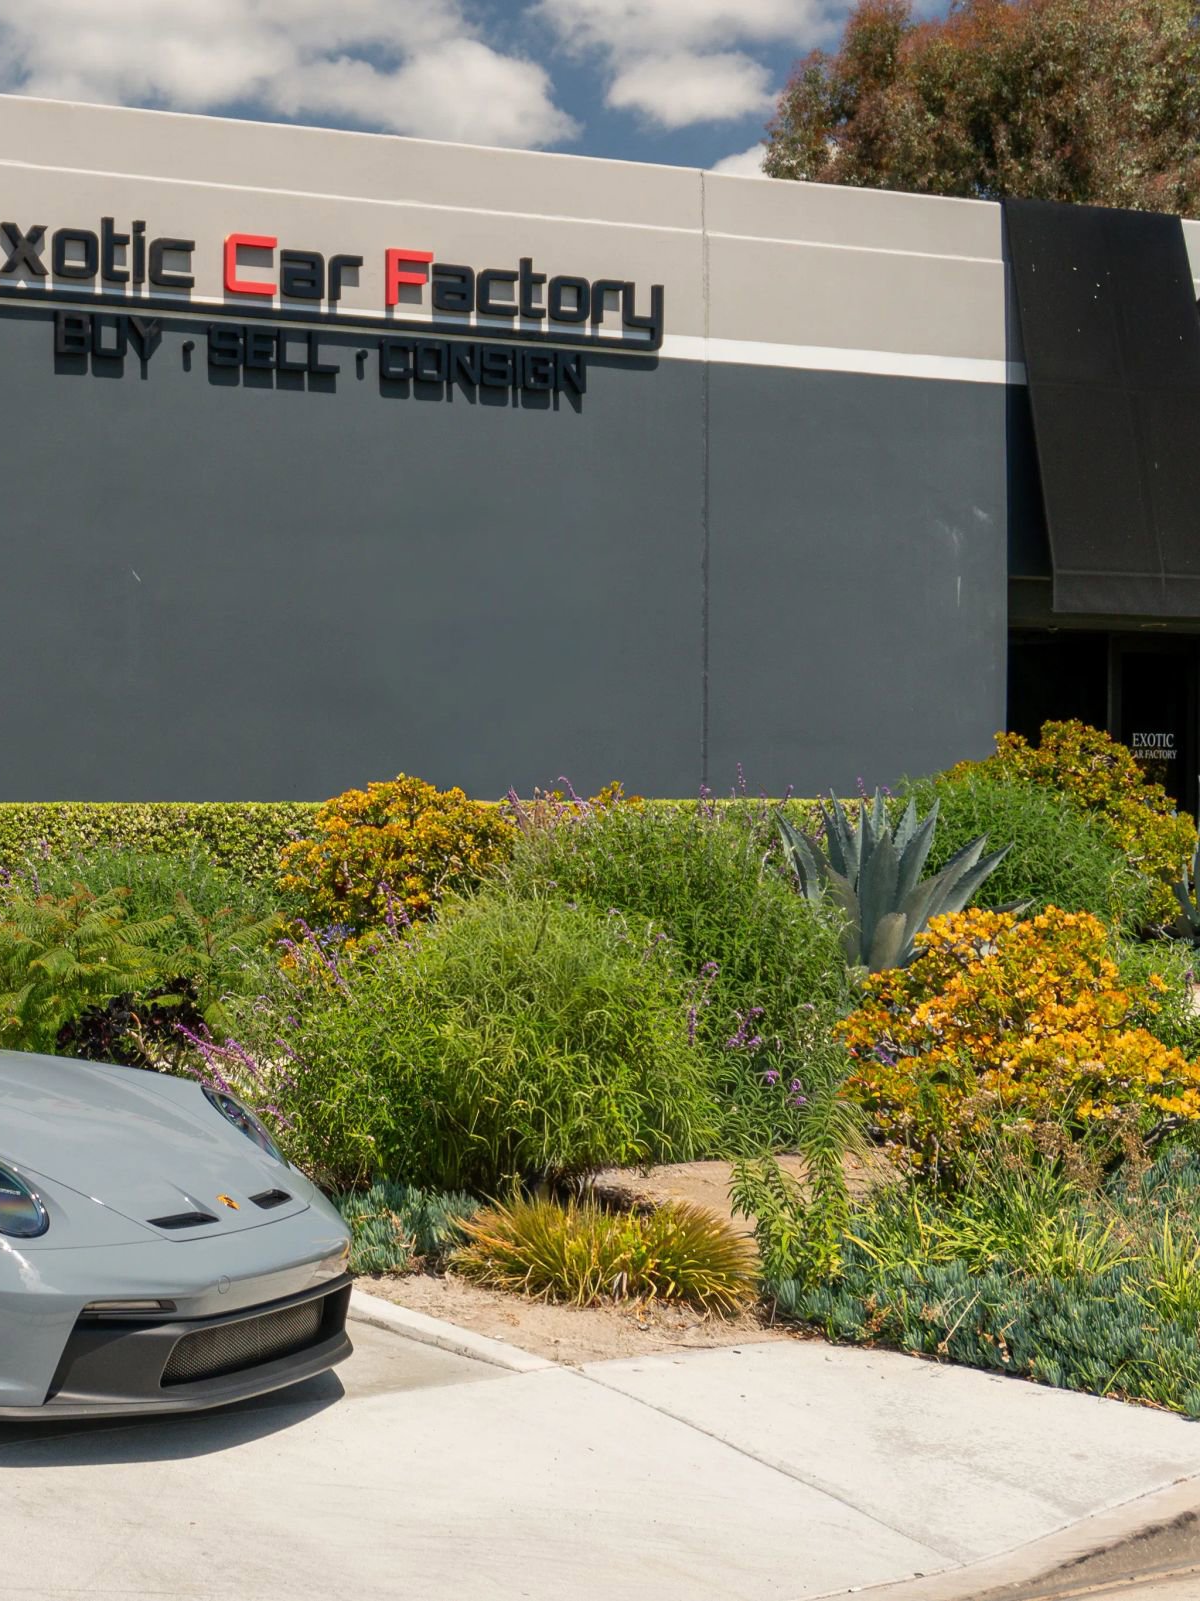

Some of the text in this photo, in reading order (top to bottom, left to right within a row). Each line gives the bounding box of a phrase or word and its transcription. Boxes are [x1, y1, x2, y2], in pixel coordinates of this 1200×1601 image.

[224, 233, 364, 300] Car
[385, 248, 665, 351] Factory
[55, 311, 587, 394] BUY SELL CONSIGN
[1132, 733, 1174, 747] EXOTIC
[1145, 750, 1177, 759] FACTORY
